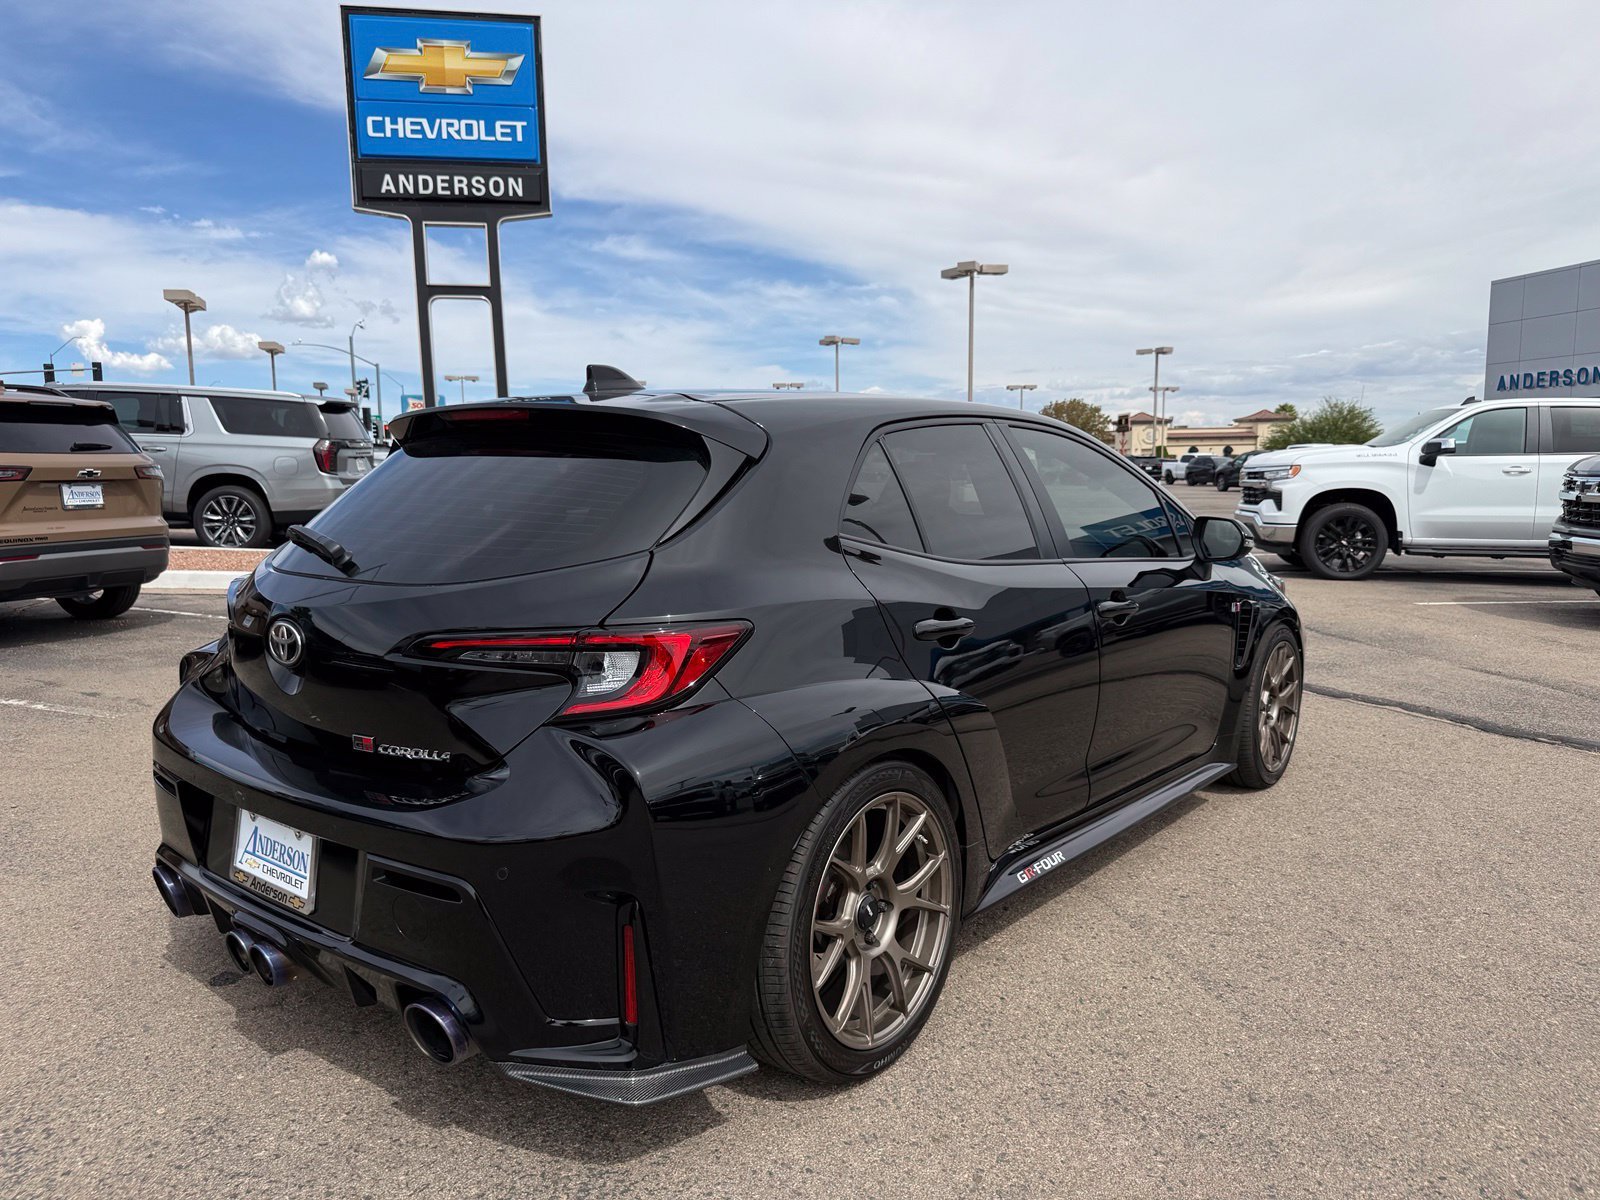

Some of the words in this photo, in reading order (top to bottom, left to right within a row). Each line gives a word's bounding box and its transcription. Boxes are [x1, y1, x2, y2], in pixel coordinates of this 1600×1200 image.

[366, 116, 527, 142] CHEVROLET
[381, 173, 523, 197] ANDERSON
[1496, 366, 1600, 391] ANDERSON
[66, 489, 101, 504] ANDERSON
[378, 744, 451, 762] COROLLA
[239, 826, 309, 873] ANDERSON
[262, 864, 304, 890] CHEVROLET
[250, 877, 288, 904] Anderson
